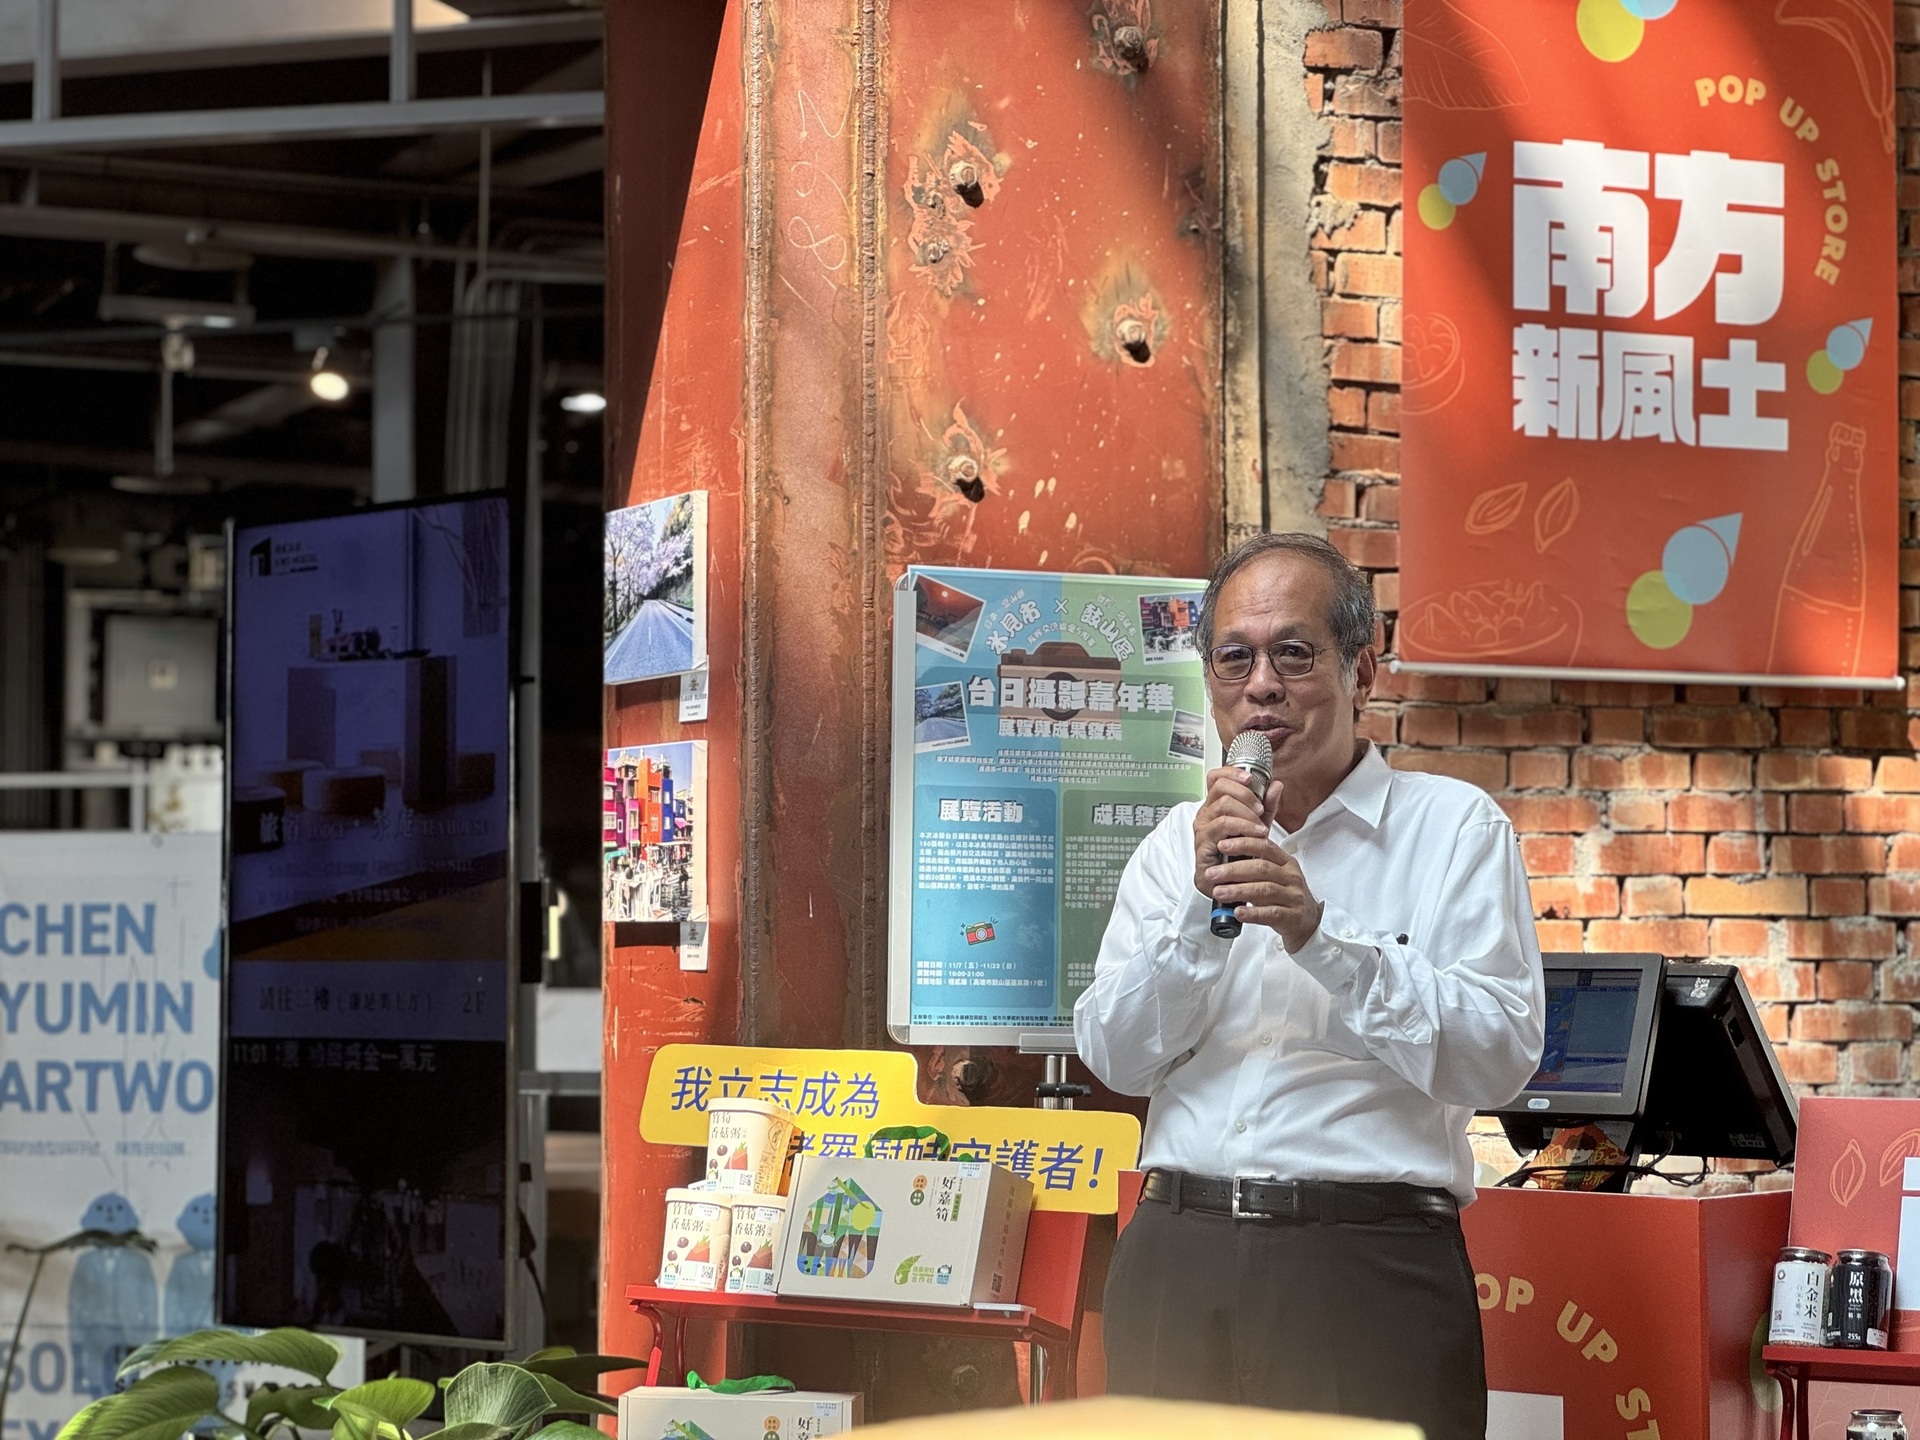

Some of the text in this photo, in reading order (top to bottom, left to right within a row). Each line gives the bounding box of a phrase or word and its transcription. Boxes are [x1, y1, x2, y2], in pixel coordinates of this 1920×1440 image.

[1694, 75, 1849, 286] POP UP STORE
[1513, 138, 1785, 326] 南方
[1511, 323, 1789, 452] 新風土
[1080, 602, 1136, 662] 鼓山區
[968, 675, 1174, 713] 台日攝影嘉年華
[998, 719, 1123, 741] 展覽與成果發表
[938, 799, 1023, 824] 展覽活動
[0, 903, 155, 956] CHEN
[0, 981, 194, 1035] YUMIN
[671, 1066, 880, 1120] 我立志成為
[673, 1202, 694, 1215] 竹筍
[736, 1207, 756, 1220] 竹筍
[935, 1177, 957, 1222] 好嘉筍
[671, 1218, 704, 1232] 香菇粥
[734, 1223, 766, 1236] 香菇粥
[1803, 1271, 1819, 1319] 白金米
[1556, 1300, 1618, 1363] UP
